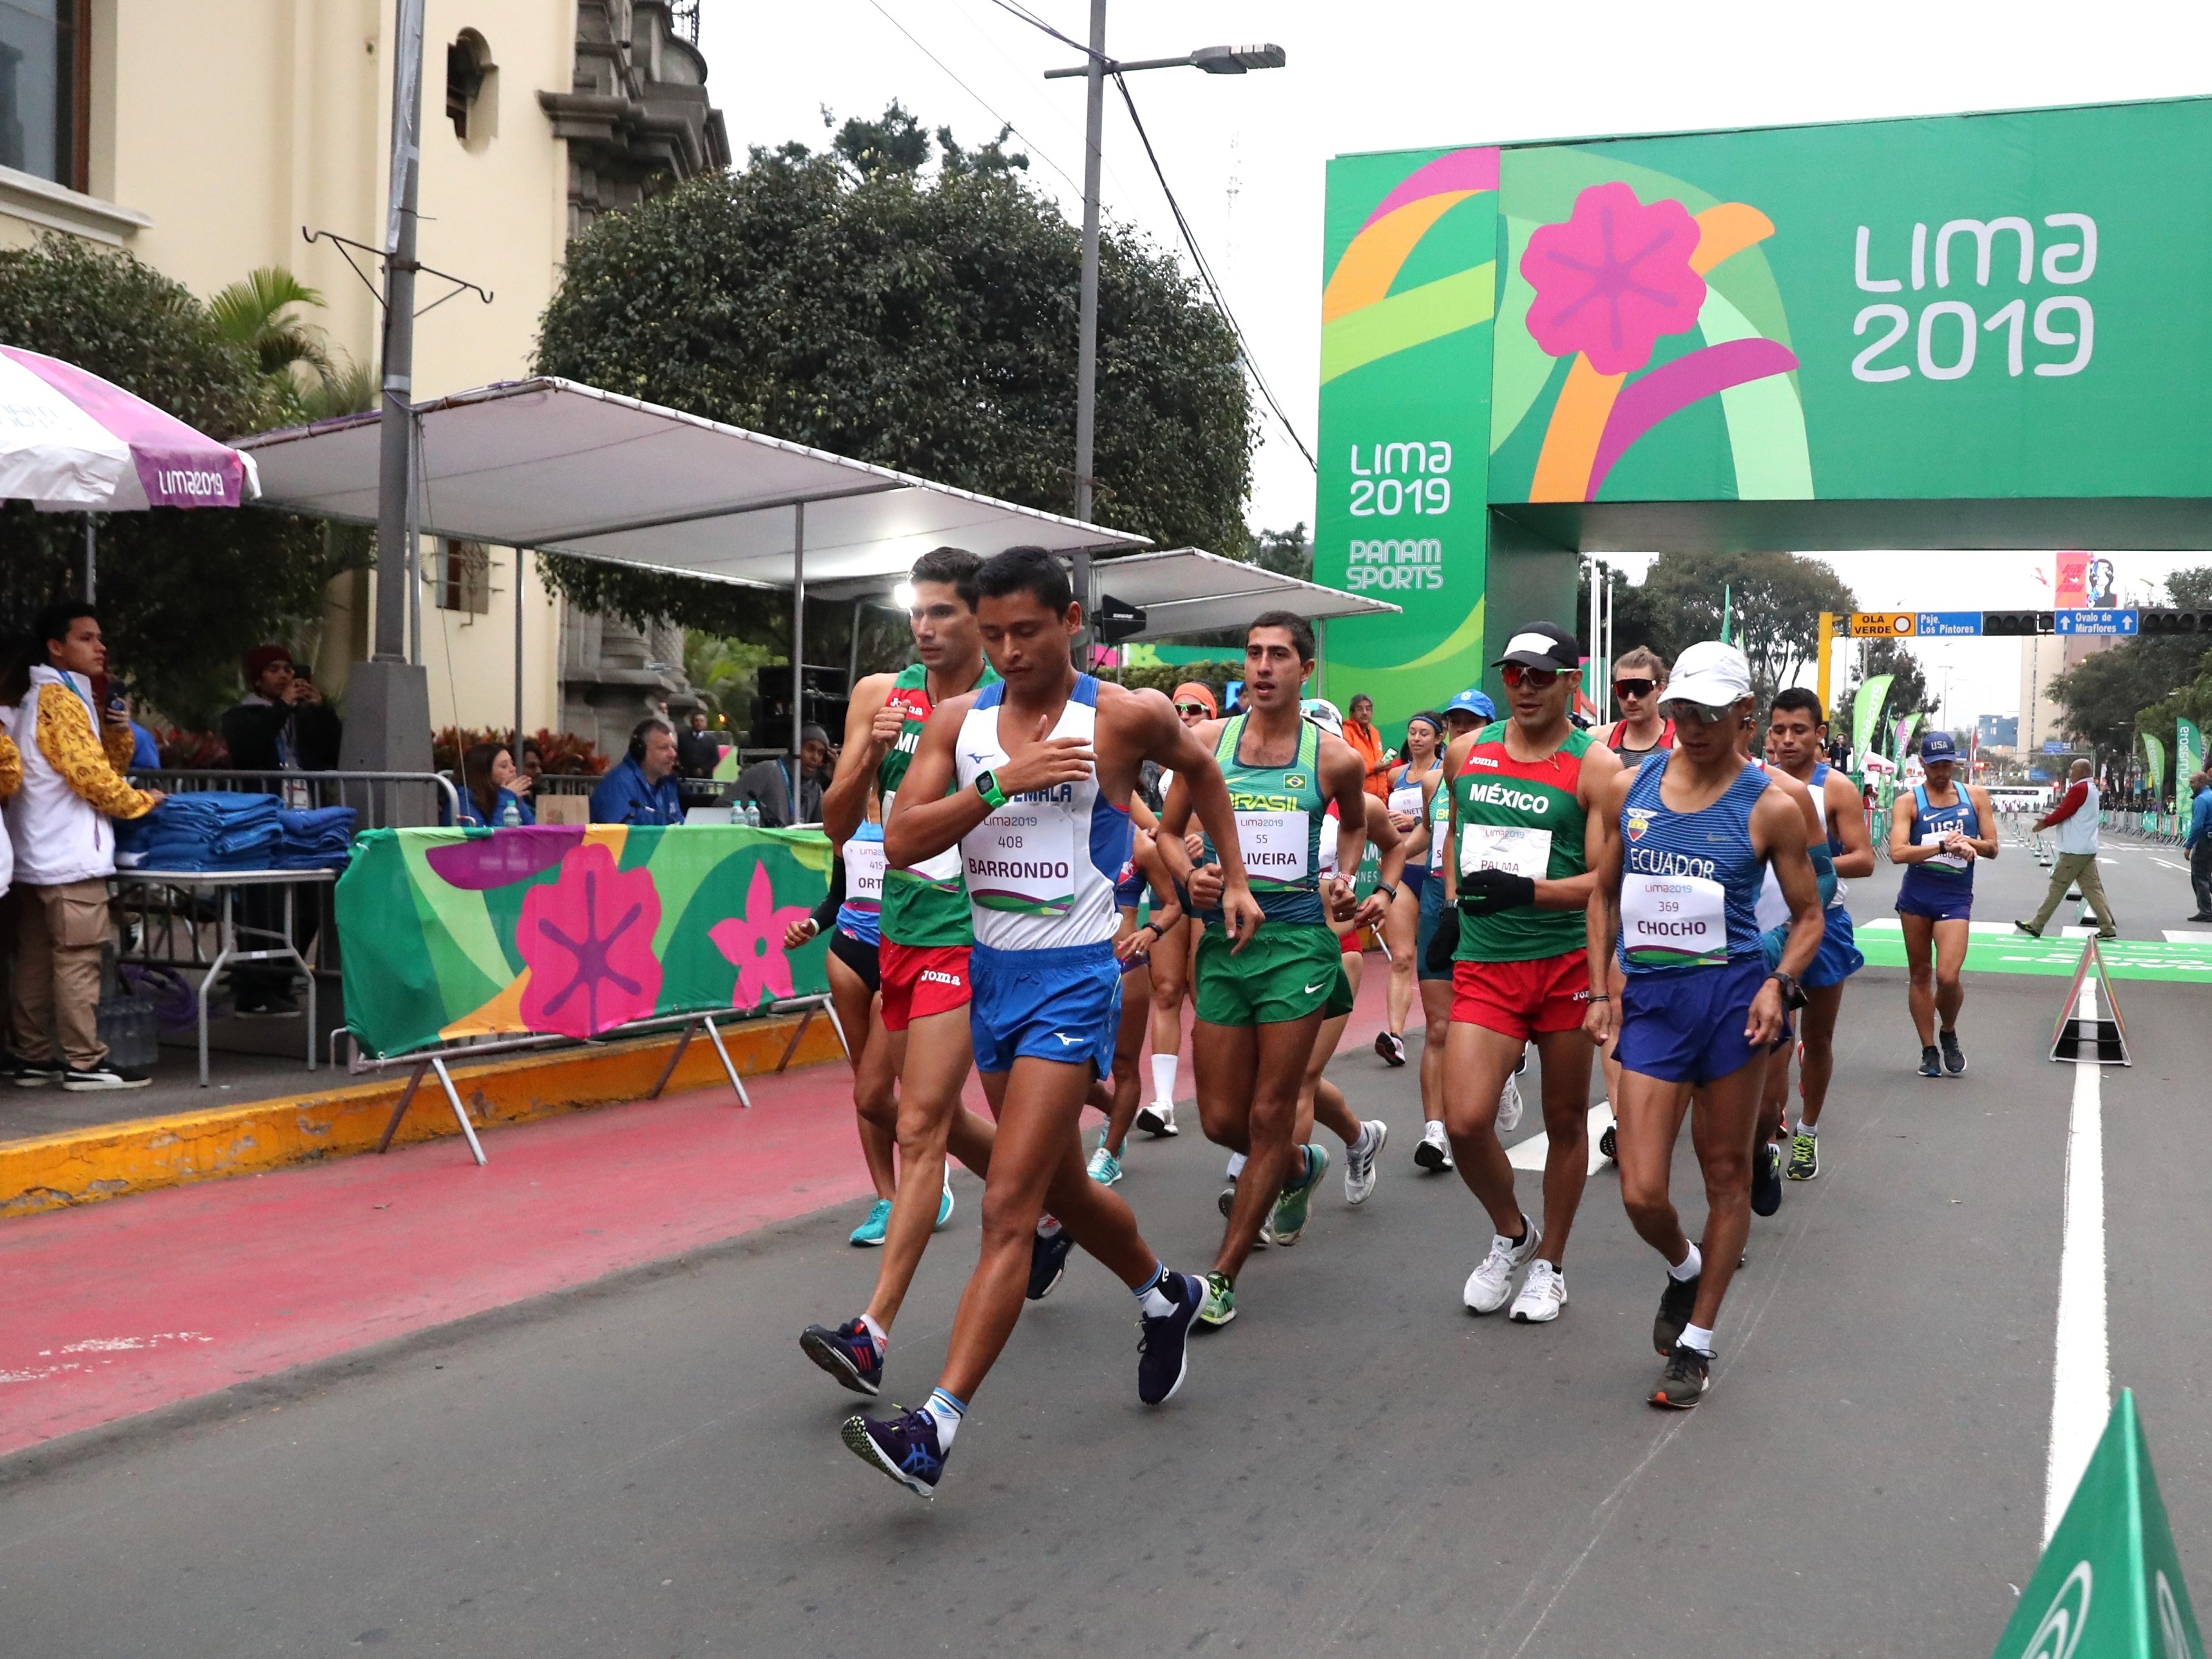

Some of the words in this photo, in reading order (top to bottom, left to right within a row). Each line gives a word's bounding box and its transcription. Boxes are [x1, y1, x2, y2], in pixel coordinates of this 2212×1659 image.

[1855, 212, 2098, 292] Lima
[1851, 295, 2094, 382] 2019
[1350, 440, 1452, 476] Lima
[1349, 478, 1450, 516] 2019
[1349, 538, 1442, 564] PANAM
[1346, 565, 1444, 590] SPORTS
[1921, 614, 1940, 625] Psje.
[2075, 613, 2098, 622] Ovalo
[2101, 613, 2112, 622] de
[1921, 625, 1935, 634] Los
[1939, 625, 1974, 634] Pintores
[2075, 623, 2116, 633] Miraflores
[1931, 741, 1948, 750] USA
[1014, 784, 1072, 802] EMALA
[1469, 782, 1549, 814] MÉXICO
[1930, 819, 1964, 835] USA
[998, 836, 1023, 849] 408
[1256, 835, 1268, 843] 55
[869, 861, 883, 870] 415
[1243, 853, 1297, 865] IVEIRA
[1630, 848, 1715, 880] ECUADOR
[969, 857, 1068, 879] BARRONDO
[858, 877, 882, 889] ORT
[1658, 901, 1678, 912] 369
[1637, 920, 1706, 936] CHOCHO
